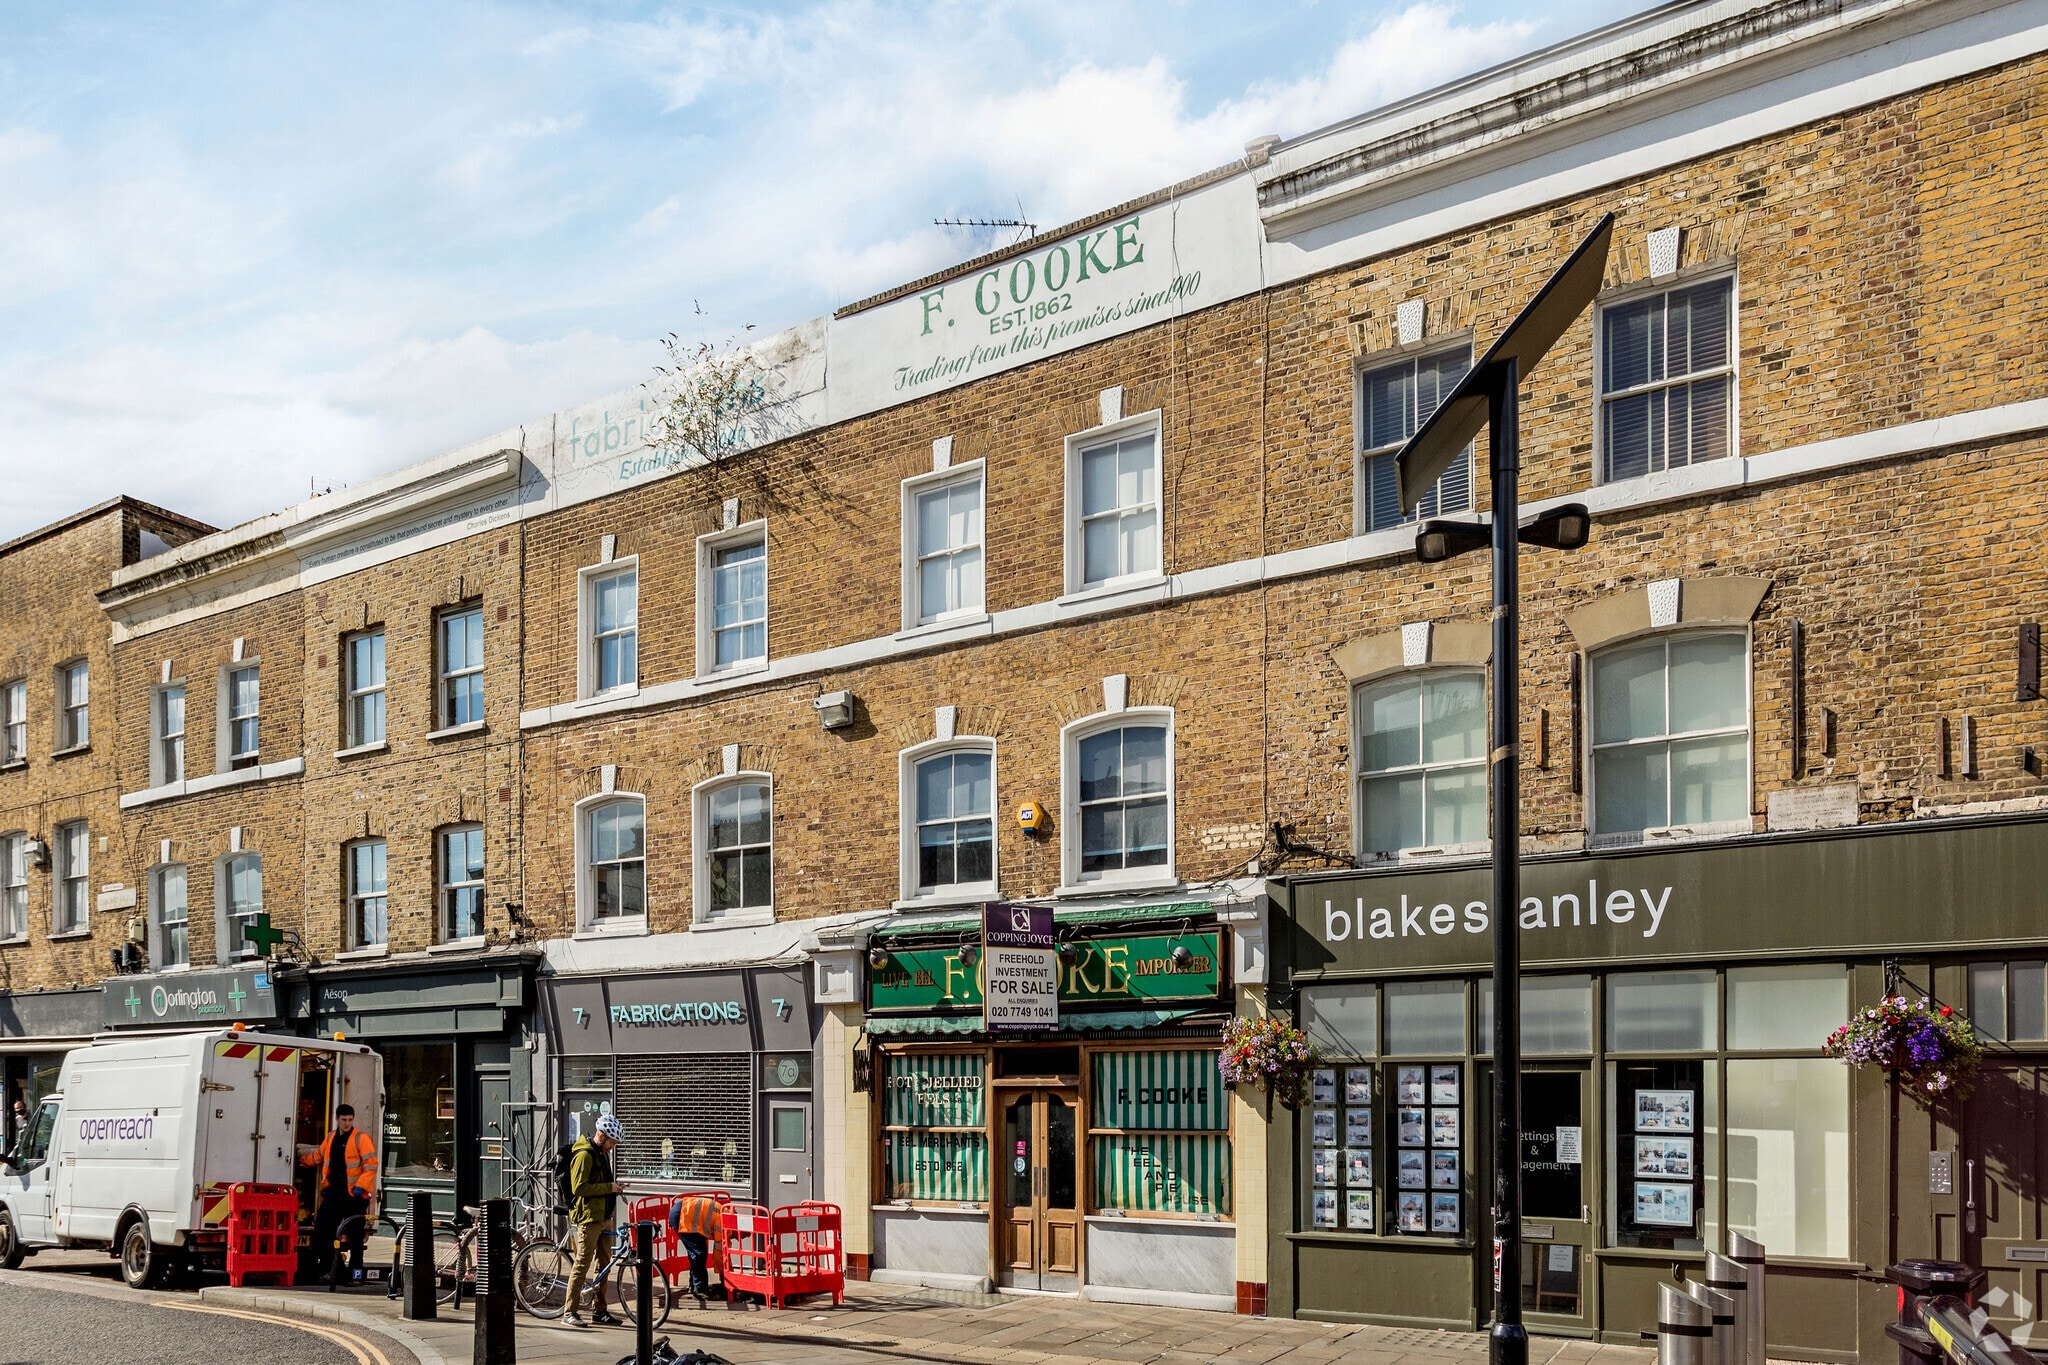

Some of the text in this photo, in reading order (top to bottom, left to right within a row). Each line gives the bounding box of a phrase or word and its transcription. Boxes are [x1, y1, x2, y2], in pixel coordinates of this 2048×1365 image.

[920, 216, 1145, 337] F. COOKE
[894, 354, 967, 391] Trading
[965, 343, 1007, 374] from
[1010, 325, 1043, 354] this
[1124, 291, 1167, 318] since
[1164, 270, 1201, 305] 1900
[466, 511, 511, 530] Charles Dickens
[1325, 879, 1673, 941] blakesanley
[987, 931, 1055, 945] COPPING JOYCE
[999, 954, 1045, 965] FREEHOLD
[882, 970, 909, 988] LIVE
[914, 969, 935, 987] EEL
[995, 967, 1049, 978] INVESTMENT
[990, 980, 1054, 995] FOR SALE
[610, 1001, 741, 1024] FABRICATIONS
[771, 998, 784, 1017] 7
[992, 1006, 1053, 1018] 020 7749 1041
[572, 1007, 584, 1025] 7
[781, 1065, 795, 1078] 7a
[926, 1076, 982, 1089] JELLIED
[917, 1092, 950, 1105] EELS
[1118, 1088, 1208, 1105] F. COOKE
[80, 1113, 153, 1145] openreach
[901, 1138, 980, 1148] EEL MERCHANTS
[1520, 1131, 1555, 1143] ettings
[1121, 1146, 1149, 1156] THE
[1530, 1145, 1539, 1156] &
[915, 1161, 940, 1171] ESTD
[1133, 1158, 1160, 1167] EEL
[1144, 1172, 1176, 1181] AND
[1156, 1183, 1178, 1193] PIE
[1163, 1195, 1209, 1206] HOUSE
